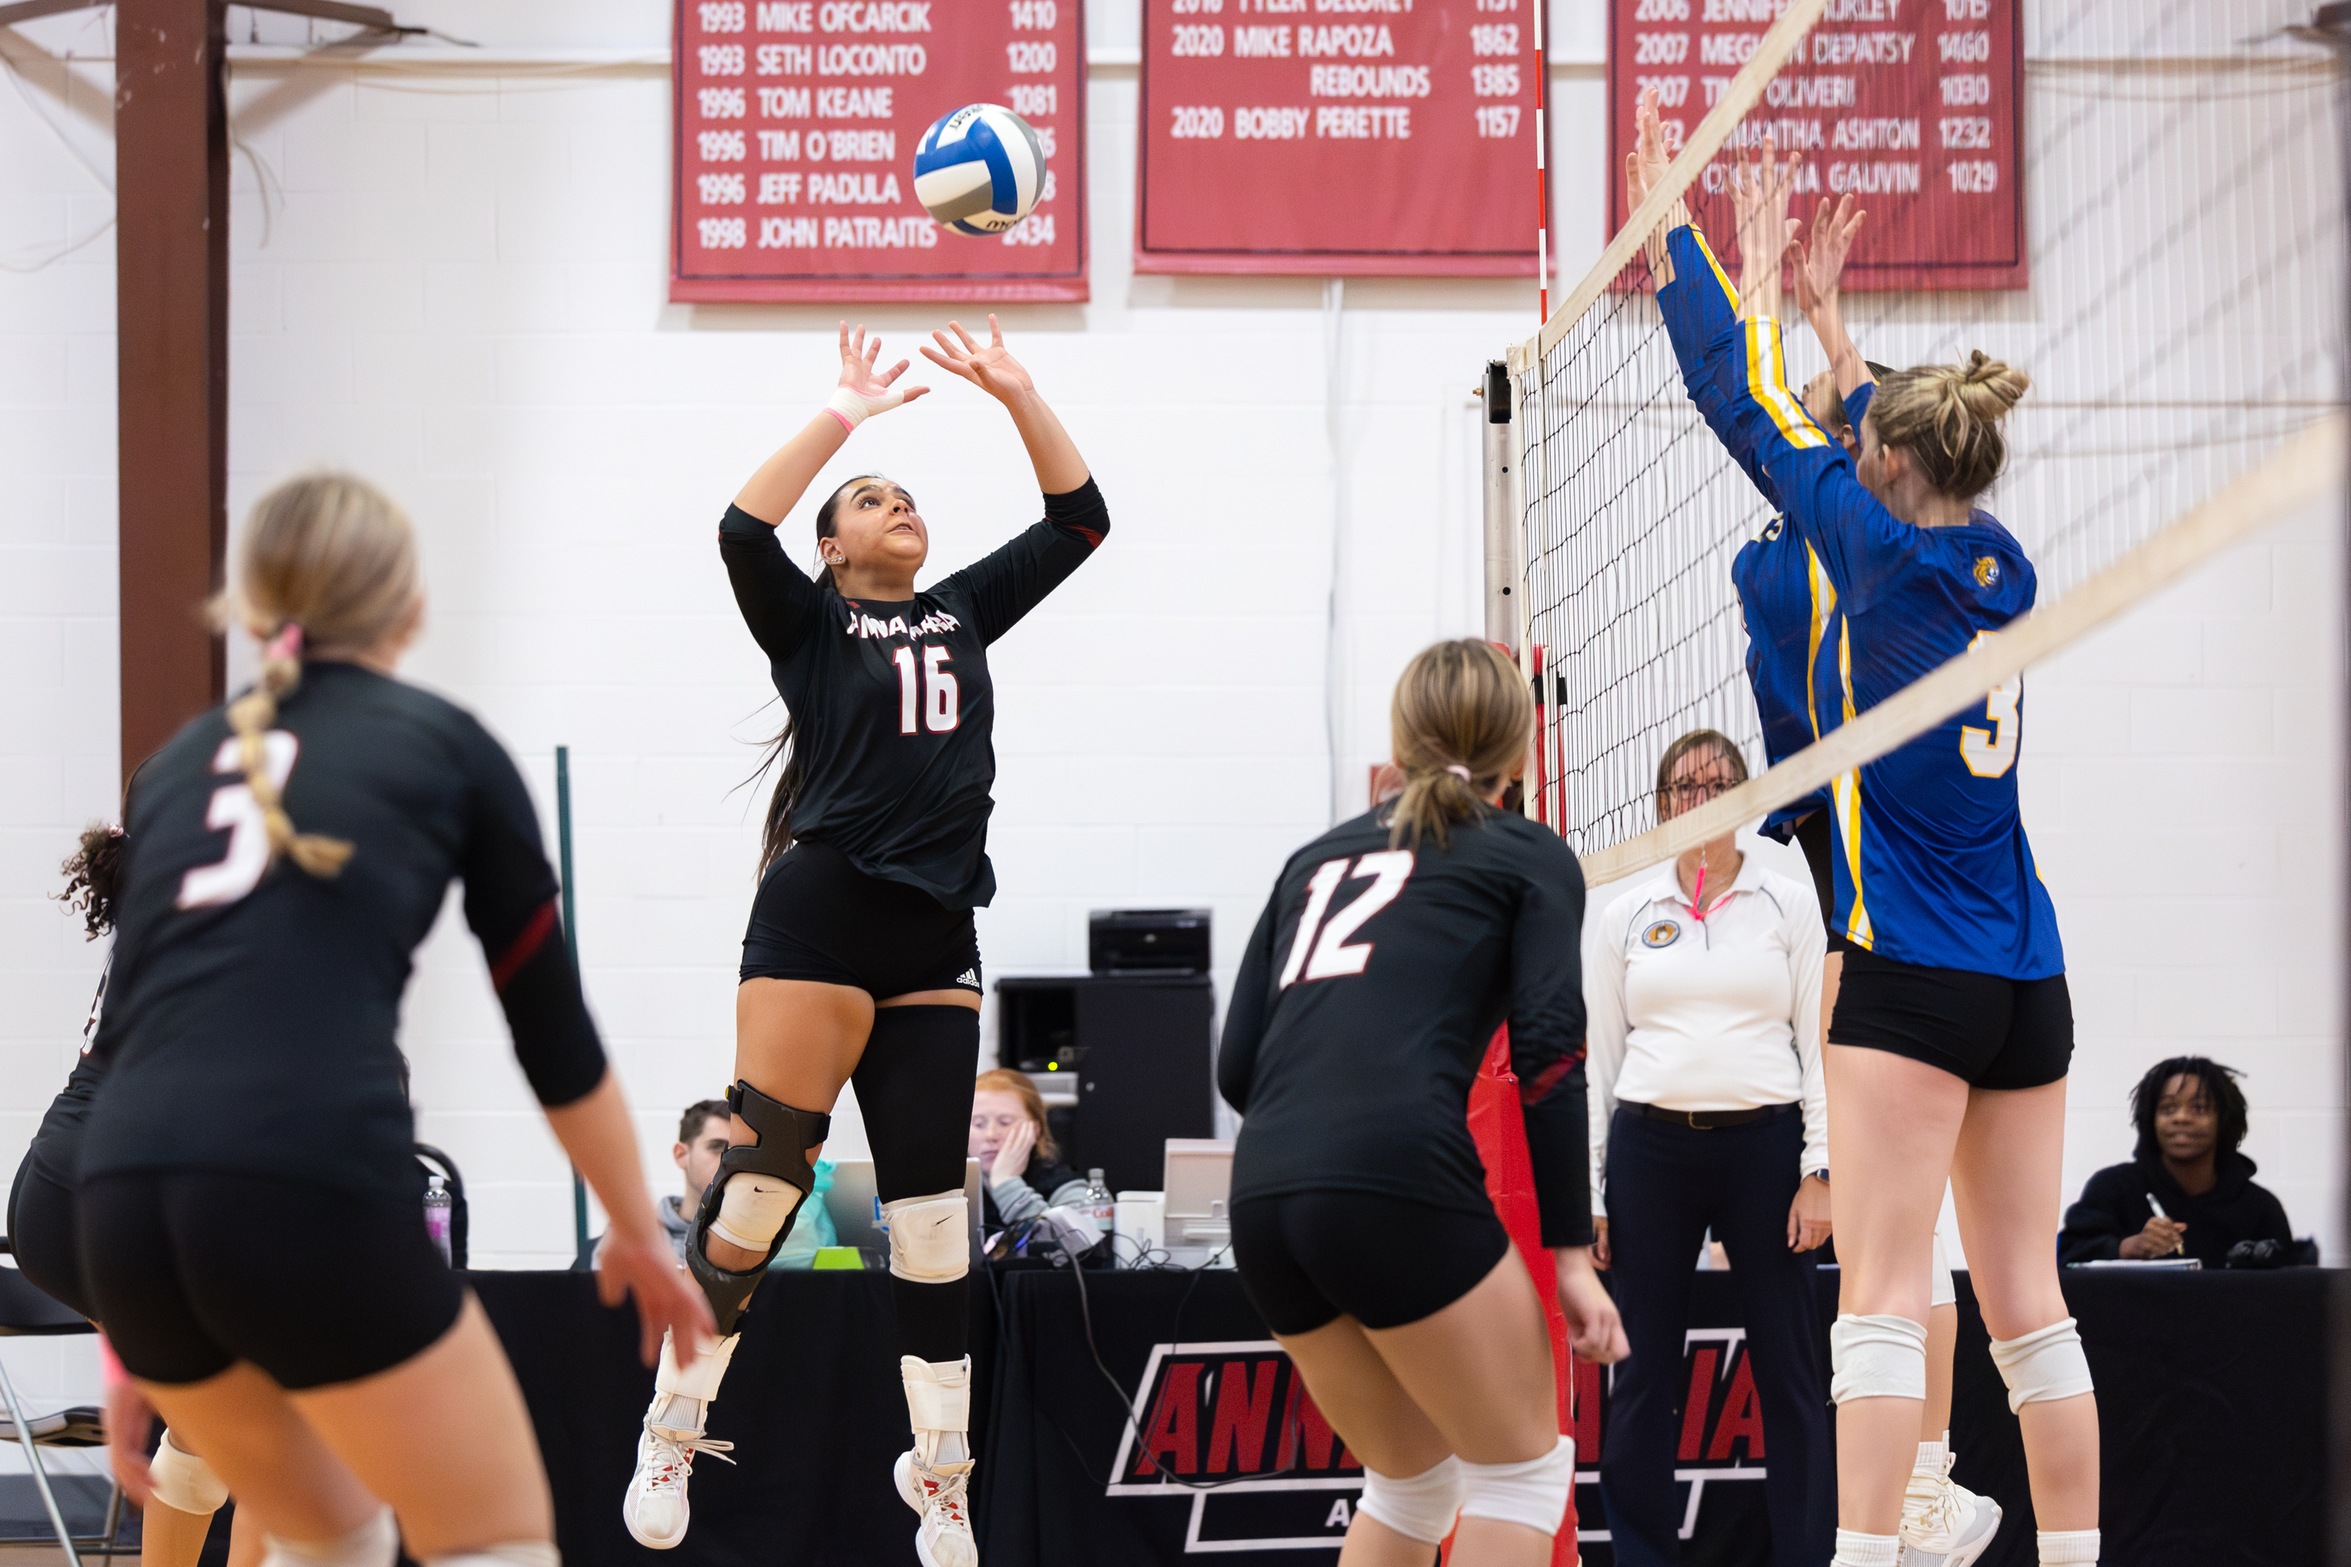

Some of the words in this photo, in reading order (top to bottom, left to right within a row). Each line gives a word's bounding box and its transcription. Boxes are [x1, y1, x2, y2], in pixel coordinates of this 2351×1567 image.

[698, 3, 744, 33] 1993
[757, 2, 812, 32] MIKE
[820, 1, 931, 32] OFCARCIK
[1010, 0, 1057, 29] 1410
[1702, 0, 1790, 21] JENNIFE
[1171, 26, 1224, 56] 2020
[1234, 26, 1291, 57] MIKE
[1298, 26, 1394, 56] RAPOZA
[1634, 32, 1690, 65] 2007
[698, 46, 745, 76] 1993
[756, 45, 811, 75] SETH
[818, 45, 926, 75] LOCONTO
[1007, 42, 1057, 73] 1200
[1311, 65, 1431, 97] REBOUNDS
[698, 88, 745, 119] 1996
[757, 88, 811, 118] TOM
[817, 88, 893, 118] KEANE
[1008, 85, 1057, 116] 1081
[1170, 108, 1223, 139] 2020
[1234, 108, 1310, 140] BOBBY
[1316, 107, 1411, 139] PERETTE
[1474, 106, 1521, 138] 1157
[1832, 117, 1921, 150] ASHTON
[1939, 117, 1991, 149] 1232
[698, 130, 745, 161] 1996
[757, 130, 800, 161] TIM
[806, 130, 895, 161] O'BRIEN
[698, 174, 745, 205] 1996
[757, 174, 801, 205] JEFF
[808, 173, 901, 204] PADULA
[1946, 160, 1998, 193] 1029
[698, 217, 746, 249] 1998
[757, 218, 818, 249] JOHN
[892, 644, 960, 736] 16
[1279, 849, 1417, 991] 12
[1134, 1360, 1362, 1475] ANN
